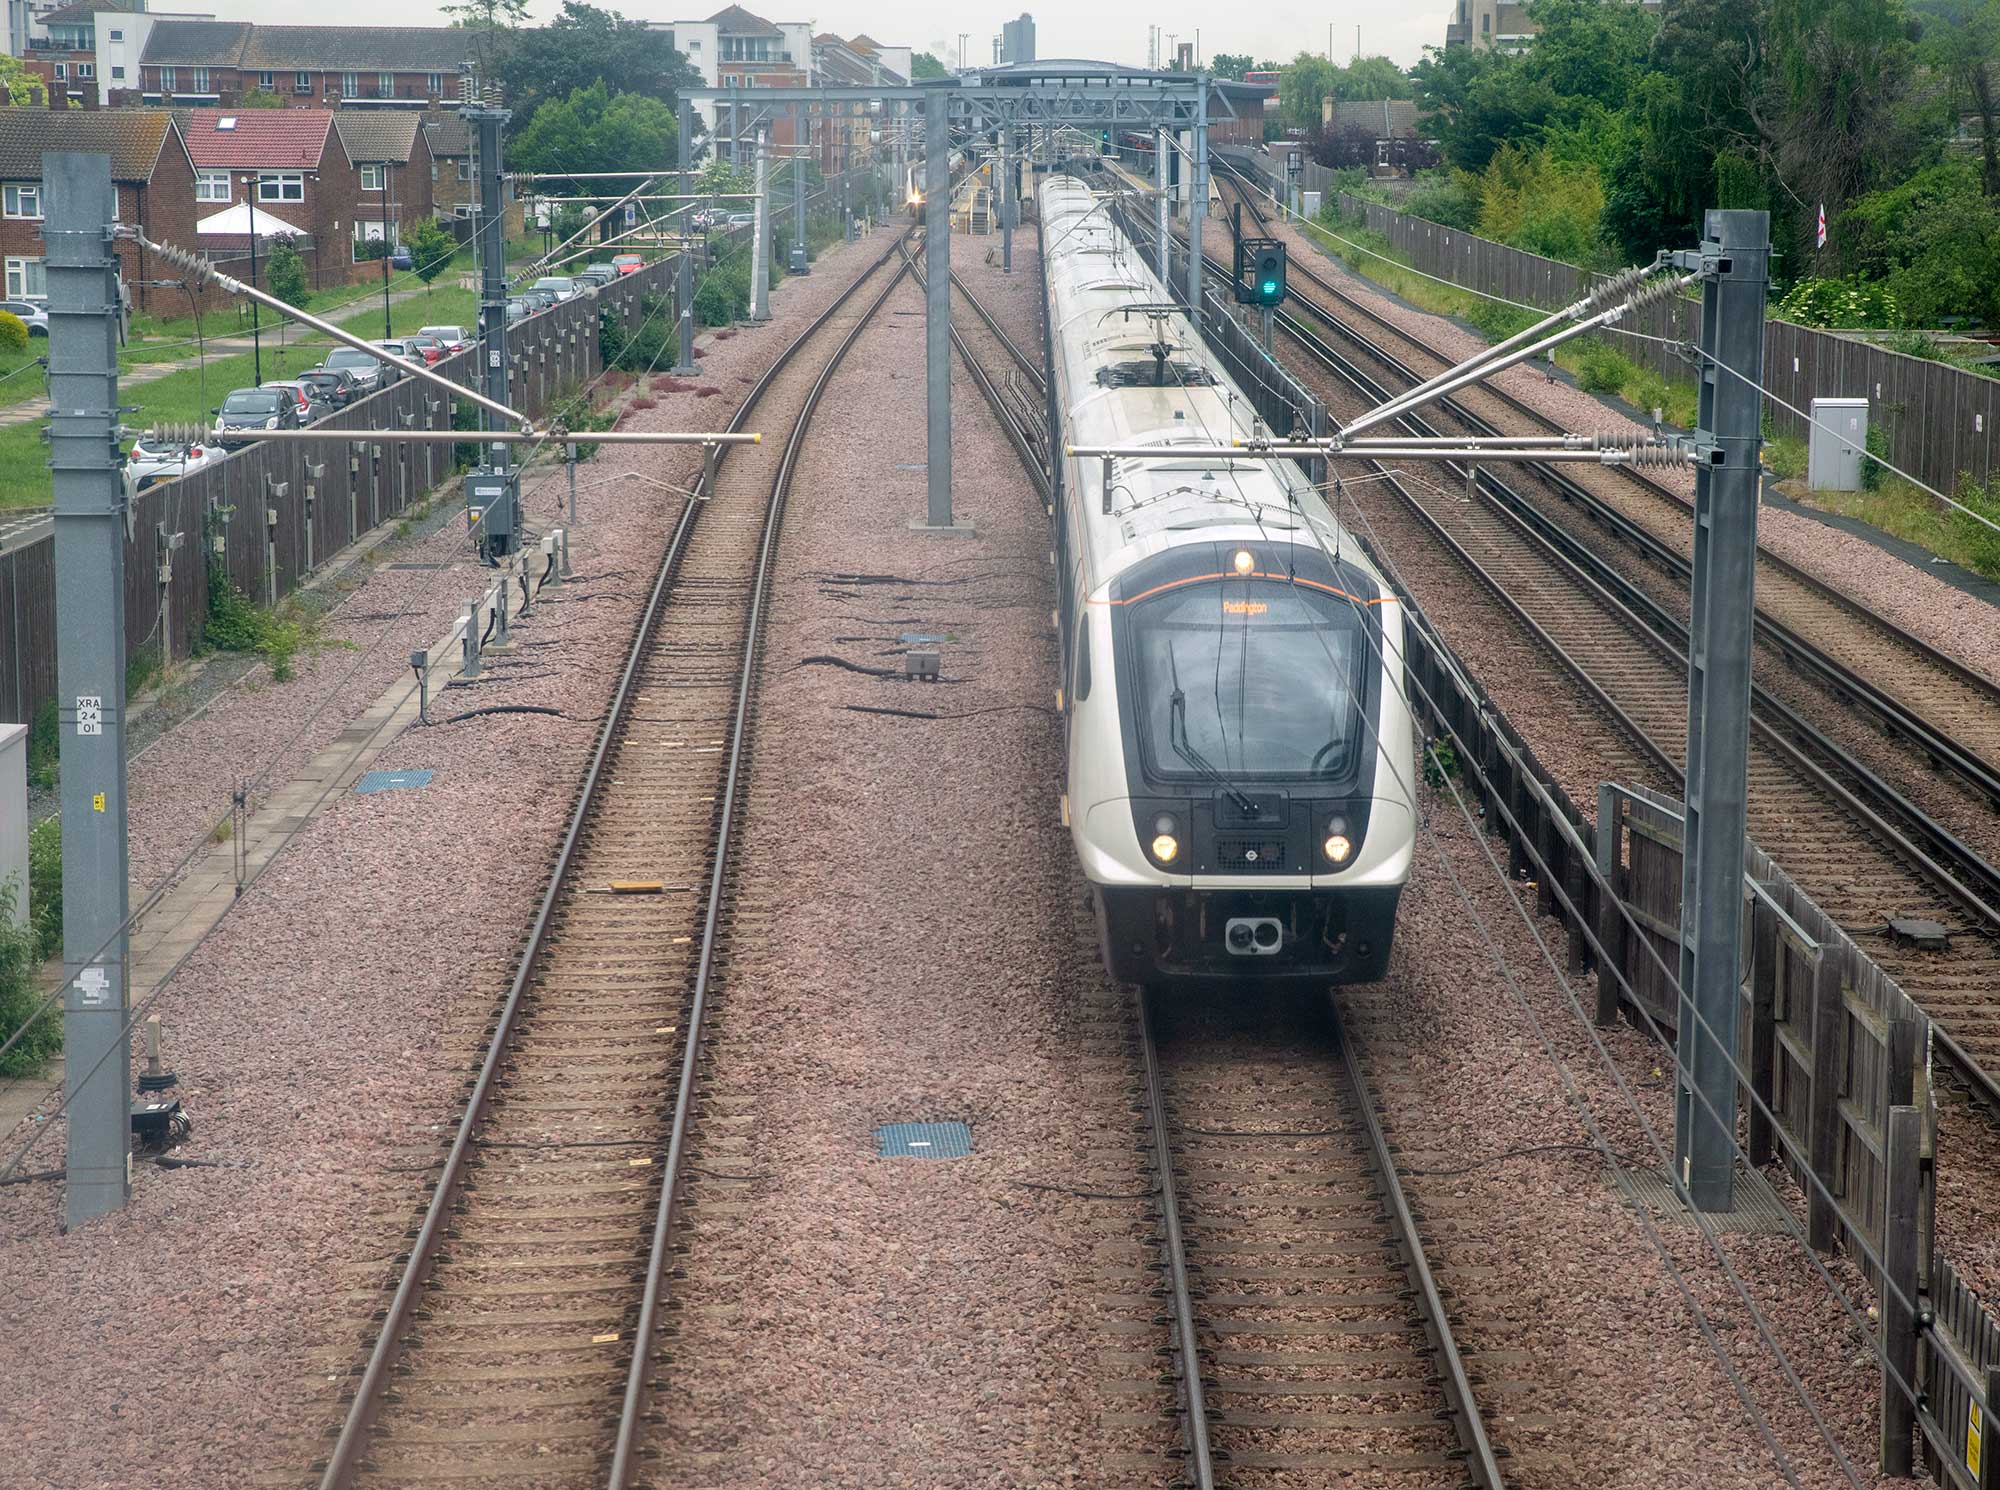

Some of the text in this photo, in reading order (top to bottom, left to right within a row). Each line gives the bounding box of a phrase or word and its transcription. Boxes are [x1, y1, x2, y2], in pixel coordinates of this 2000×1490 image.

[1223, 601, 1268, 616] Paddington
[78, 698, 100, 708] XRA
[81, 711, 97, 721] 24
